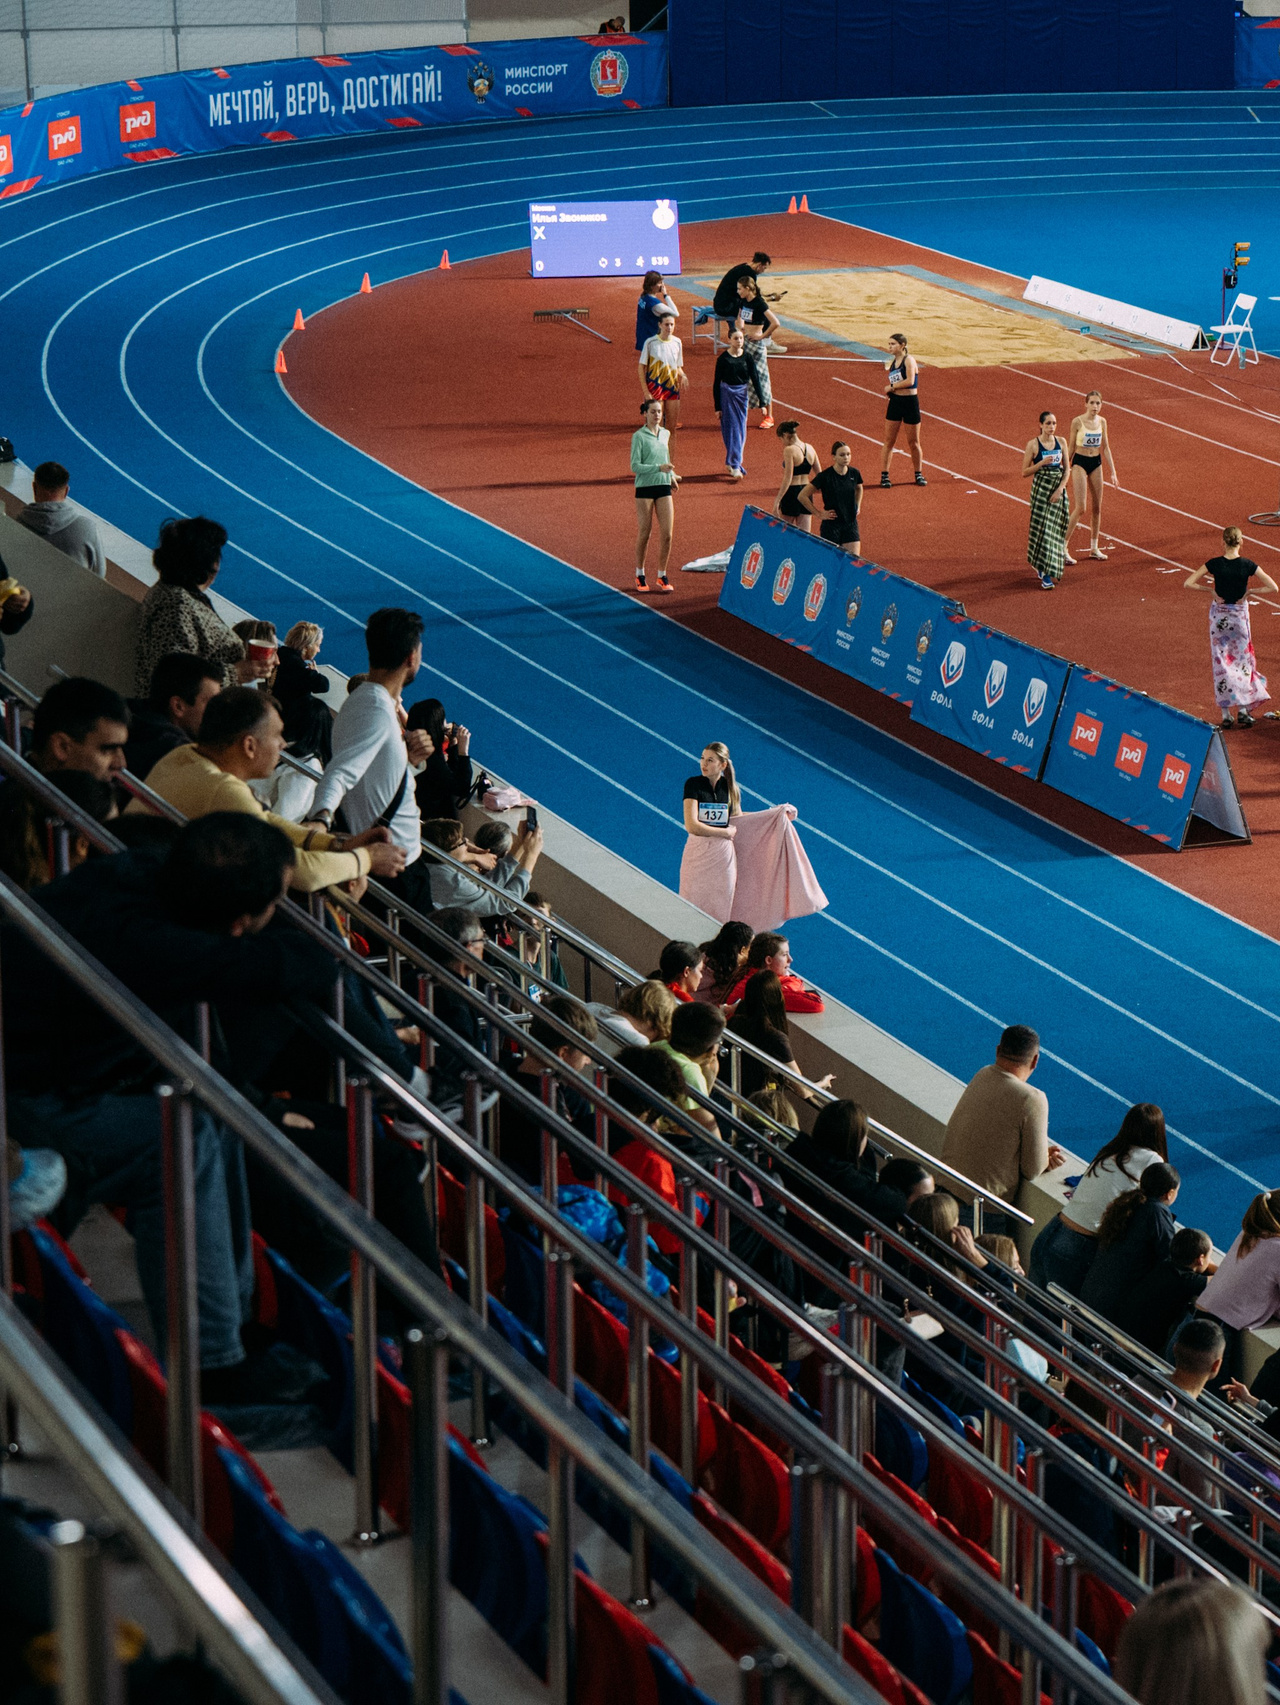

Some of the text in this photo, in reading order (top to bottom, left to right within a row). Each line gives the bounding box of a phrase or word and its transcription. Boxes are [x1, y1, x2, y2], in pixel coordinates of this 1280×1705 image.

[505, 64, 568, 79] МИНСПОРТ
[209, 65, 442, 127] МЕЧТАЙ, ВЕРЬ, ДОСТИГАЙ!
[505, 81, 553, 96] РОССИИ
[931, 690, 952, 709] ВФЛА
[971, 710, 994, 729] ВФЛА
[1012, 729, 1034, 748] ВФЛА
[704, 810, 723, 821] 137
